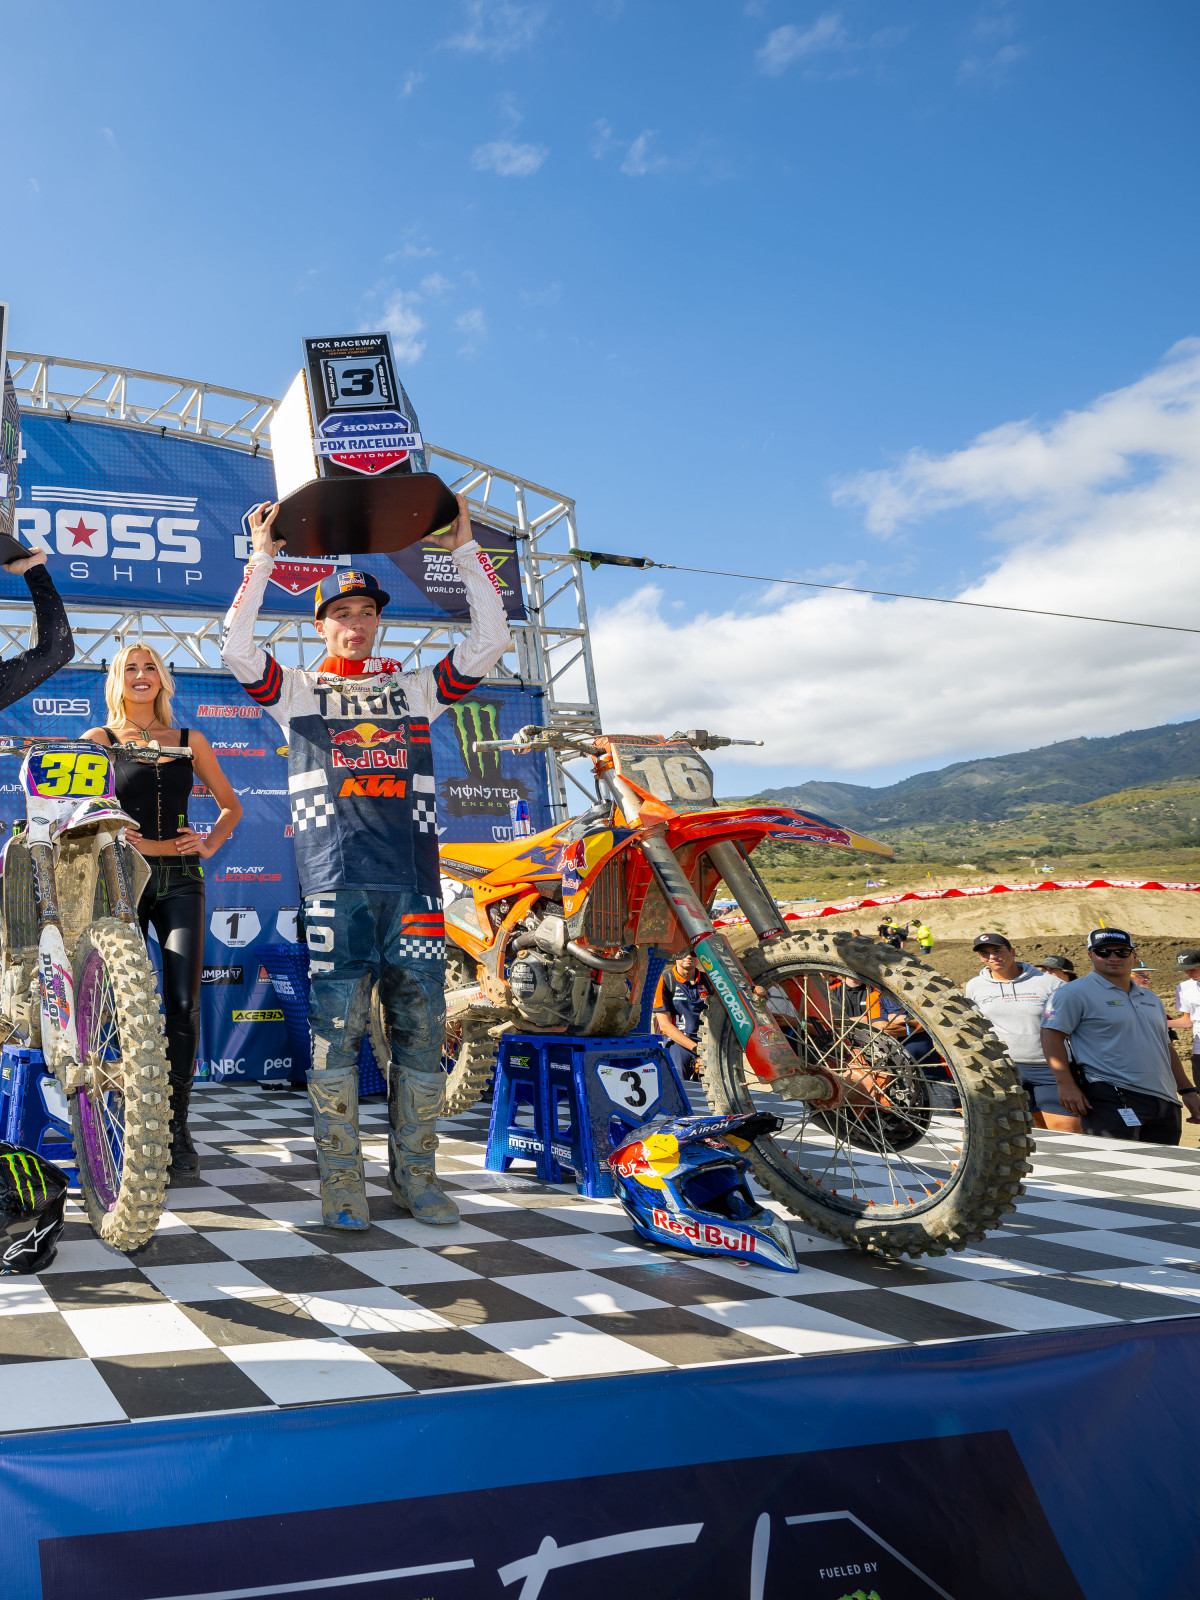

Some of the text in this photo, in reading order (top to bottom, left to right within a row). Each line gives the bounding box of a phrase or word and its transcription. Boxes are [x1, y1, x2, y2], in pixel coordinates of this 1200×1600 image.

[311, 338, 382, 349] FOX RACEWAY
[341, 368, 375, 397] 3
[342, 422, 407, 432] HONDA
[320, 436, 416, 451] FOX RACEWAY
[422, 554, 453, 564] SUP
[272, 564, 327, 574] ATIONAL
[426, 563, 459, 573] MOT
[423, 572, 463, 583] CROS
[426, 586, 455, 594] WORLD
[33, 698, 91, 716] WPS
[313, 687, 410, 717] THOR
[211, 741, 250, 749] MX-ATV
[212, 748, 267, 758] EGENDS
[332, 749, 408, 770] Red Bull
[36, 752, 108, 797] 38
[630, 756, 712, 801] 16
[339, 774, 407, 799] KTM
[449, 785, 520, 800] MONSTER
[225, 866, 265, 874] MX-ATV
[214, 873, 282, 884] LEGENDS
[202, 969, 230, 978] UMPH
[707, 969, 749, 1029] MOTOREX
[234, 1011, 284, 1020] ACERBIS
[210, 1058, 246, 1076] NBC
[619, 1071, 647, 1108] 3
[688, 1120, 730, 1136] AIROH
[653, 1207, 756, 1253] Red Bull
[819, 1562, 878, 1579] FUELED BY
